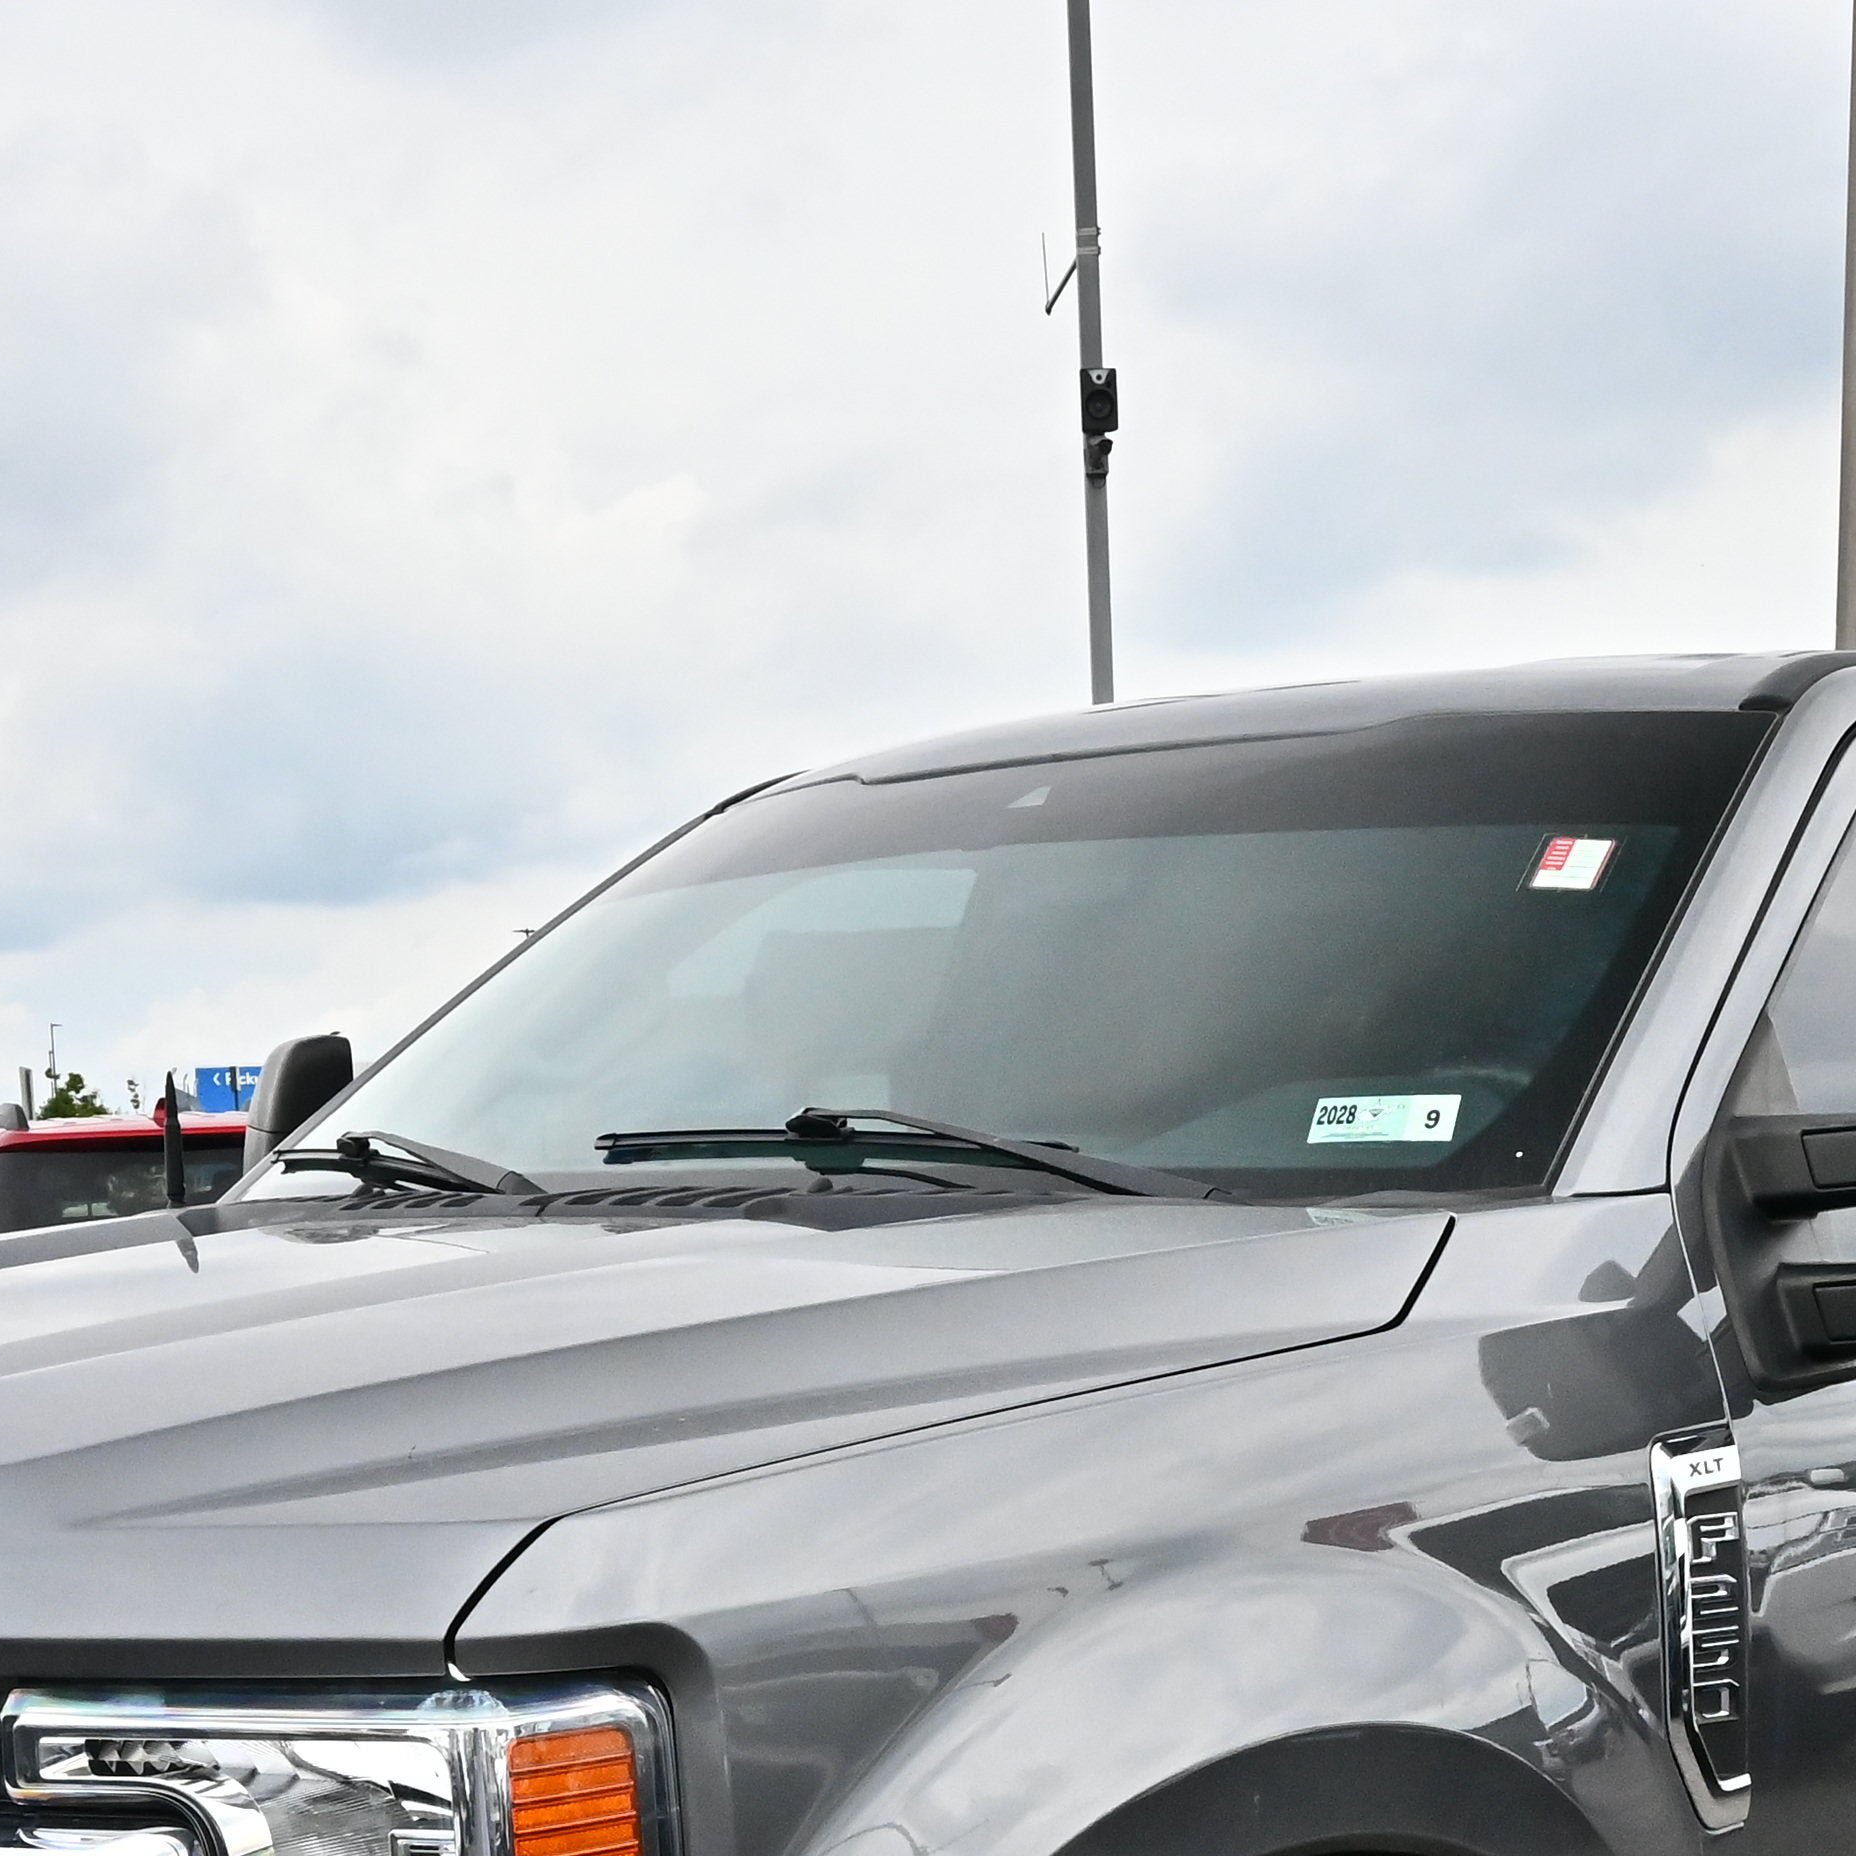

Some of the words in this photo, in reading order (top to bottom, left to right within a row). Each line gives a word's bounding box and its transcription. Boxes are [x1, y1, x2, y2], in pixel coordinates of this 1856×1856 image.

[1316, 1104, 1358, 1126] 2028
[1424, 1109, 1441, 1130] 9
[1688, 1457, 1725, 1477] XLT
